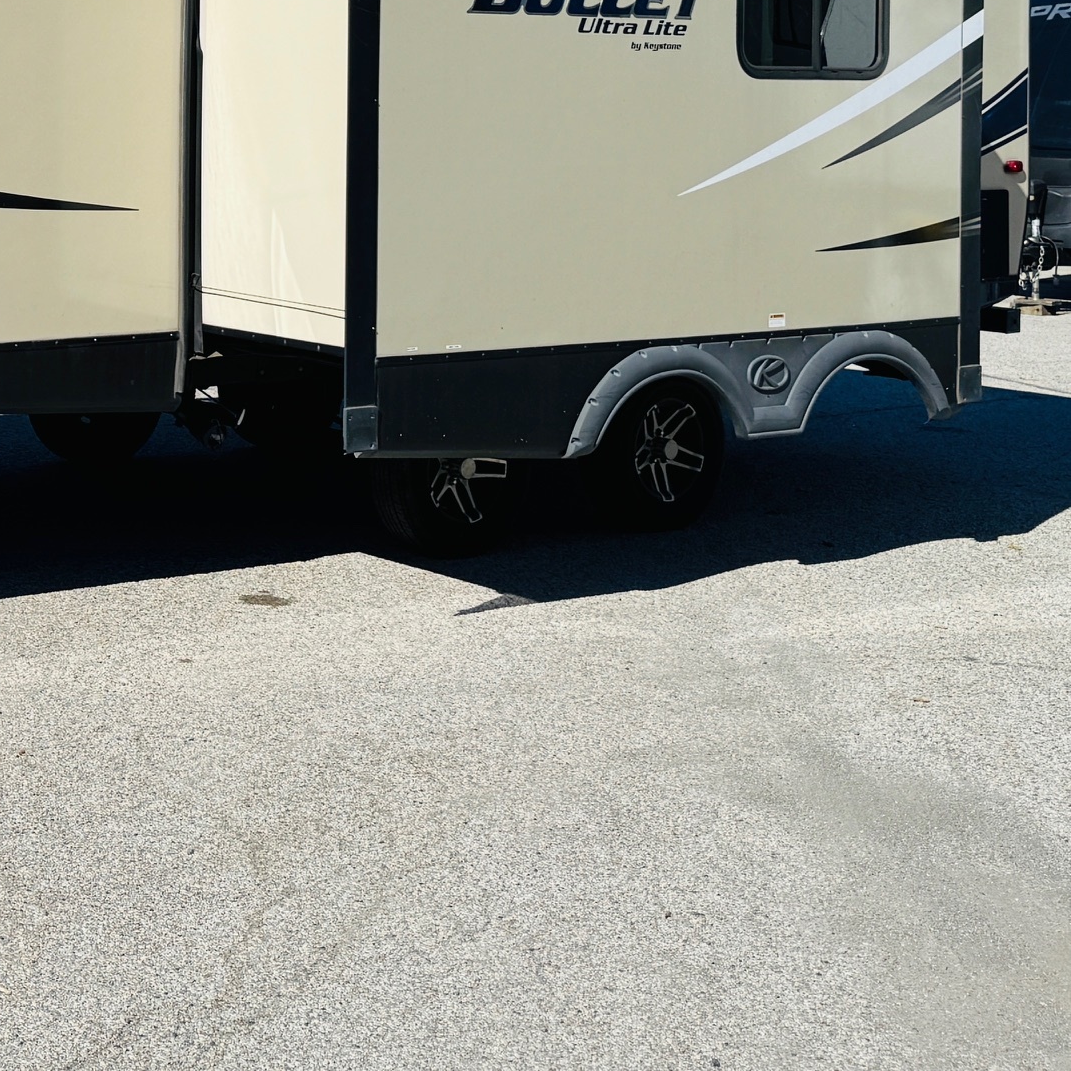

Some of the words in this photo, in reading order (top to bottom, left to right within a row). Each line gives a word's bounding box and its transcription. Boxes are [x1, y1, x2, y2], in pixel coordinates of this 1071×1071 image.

[577, 17, 638, 35] Ultra
[643, 19, 688, 36] Lite
[630, 41, 642, 52] by
[643, 41, 682, 52] Keystone
